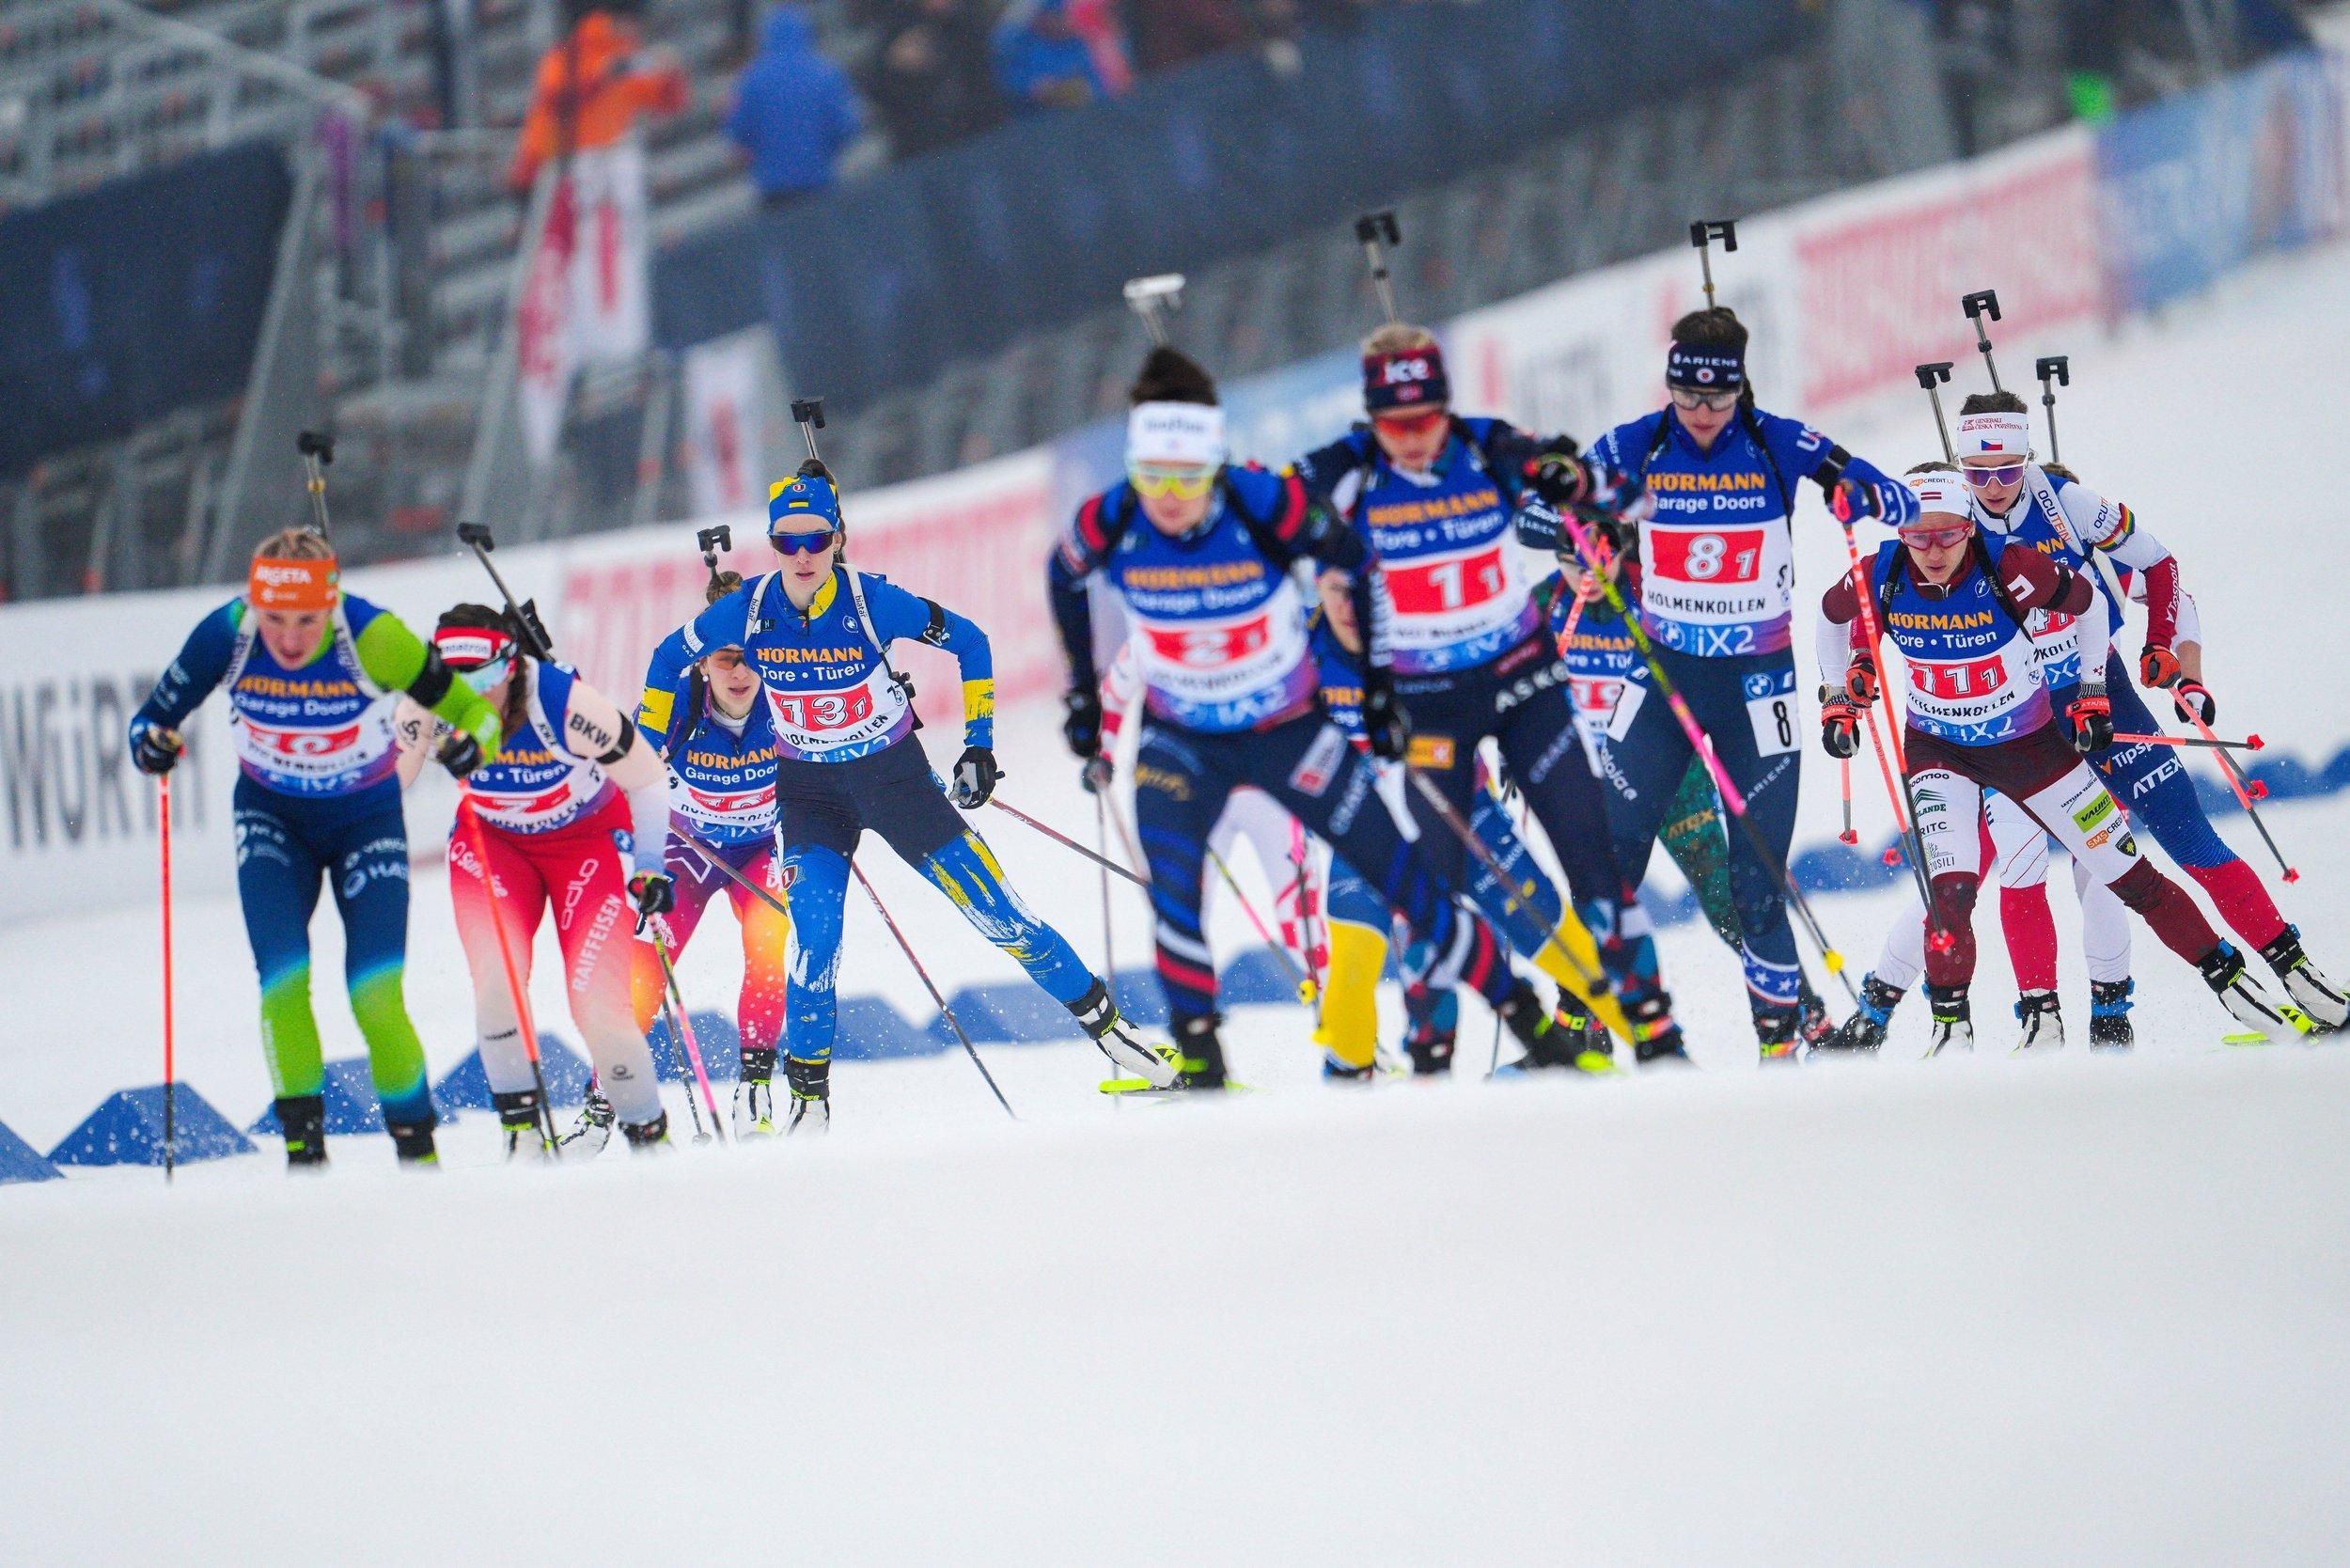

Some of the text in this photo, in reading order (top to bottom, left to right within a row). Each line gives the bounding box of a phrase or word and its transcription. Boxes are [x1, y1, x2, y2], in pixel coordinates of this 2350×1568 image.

[1681, 355, 1738, 368] ARIENS
[1645, 472, 1766, 492] HÖRMANN
[1713, 494, 1766, 510] Doors
[2038, 490, 2072, 542] OCUTEIN
[2094, 496, 2108, 529] OCUT
[1684, 533, 1727, 579] 8
[1430, 563, 1464, 610] 1
[1647, 589, 1765, 614] HOLMENKOLLEN
[1888, 609, 1994, 631] HÖRMANN
[757, 646, 864, 664] HÖRMANN
[1697, 624, 1757, 657] iX2
[1943, 631, 1998, 649] Türen
[760, 663, 866, 682] Tore Türen
[781, 696, 847, 729] 13
[1773, 700, 1792, 748] 8
[569, 713, 612, 749] BKW
[494, 750, 558, 766] MANN
[509, 763, 567, 785] Türen
[685, 763, 779, 785] Garage Doo
[687, 745, 779, 770] HÖRMAN
[1747, 755, 1792, 801] ARIENS
[2133, 755, 2183, 799] ATEX
[2087, 831, 2107, 848] SMS
[2107, 814, 2123, 834] CRED
[560, 857, 600, 931] odlo
[571, 893, 623, 993] RAIFFEISEN
